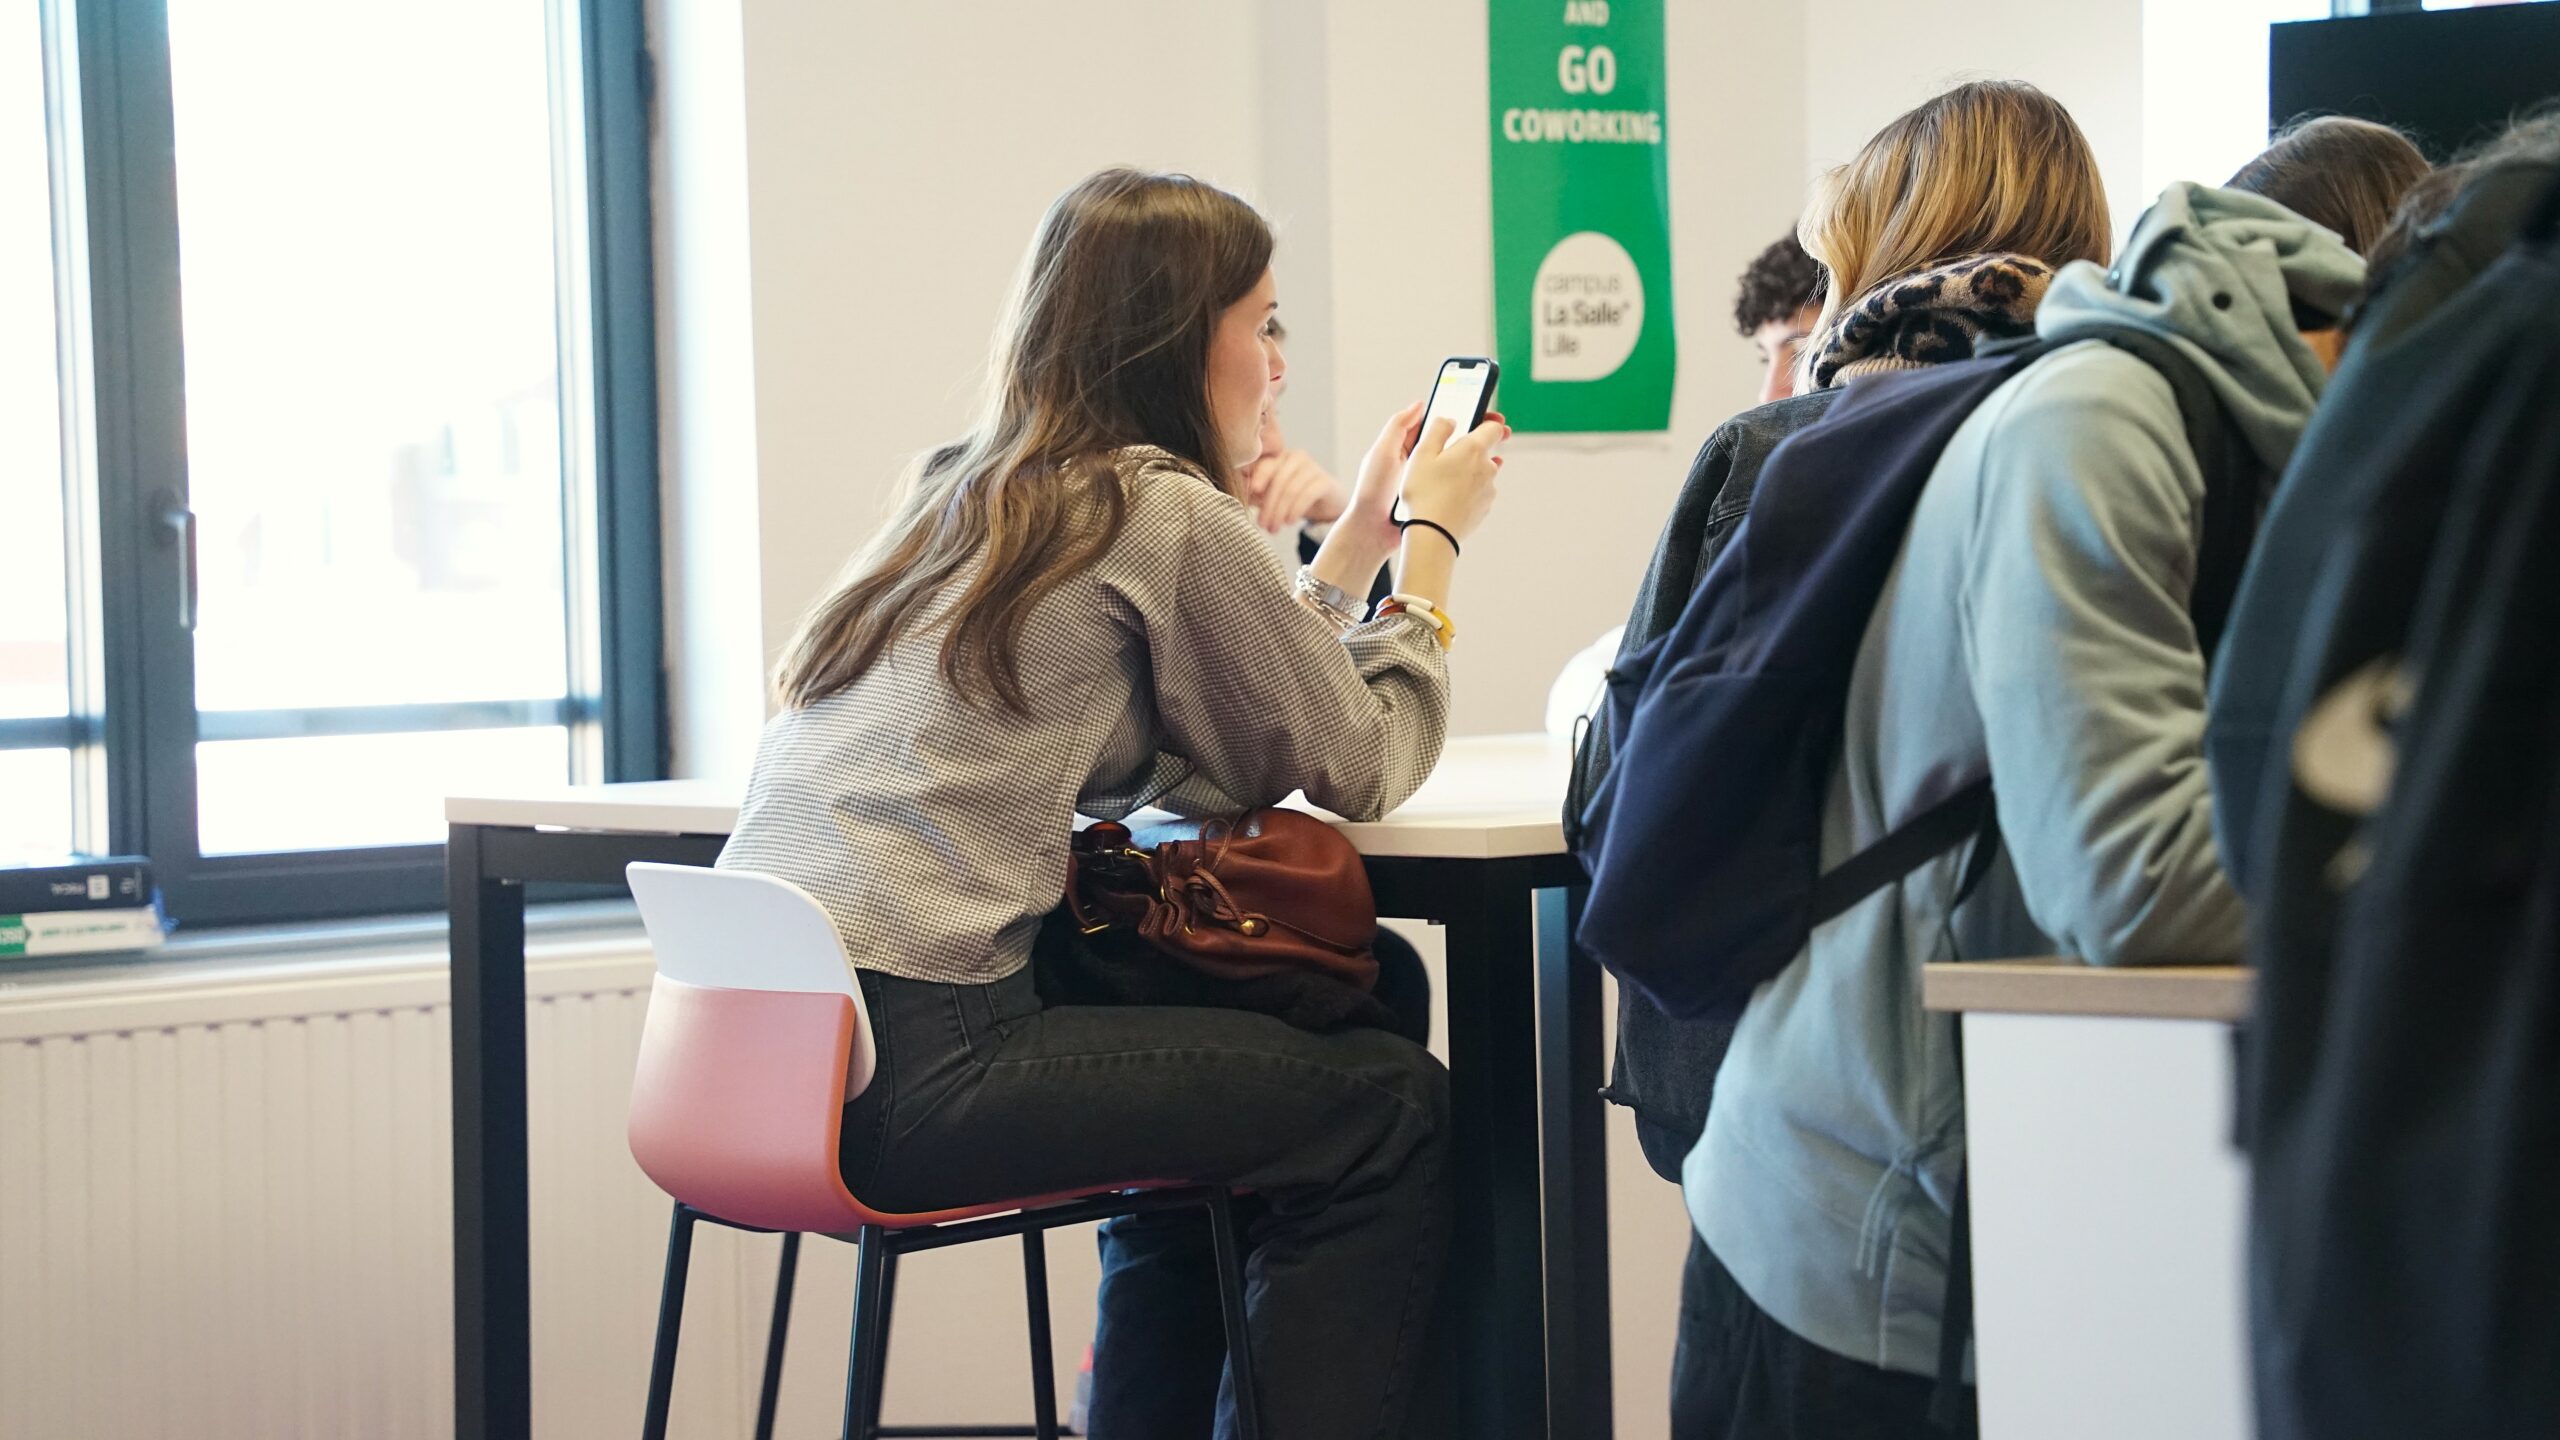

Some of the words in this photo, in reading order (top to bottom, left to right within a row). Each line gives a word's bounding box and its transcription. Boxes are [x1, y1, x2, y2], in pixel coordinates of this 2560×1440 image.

[1564, 0, 1610, 26] AND
[1558, 45, 1617, 95] GO
[1503, 108, 1661, 144] COWORKING
[1545, 274, 1622, 296] campus
[1544, 301, 1568, 326] La
